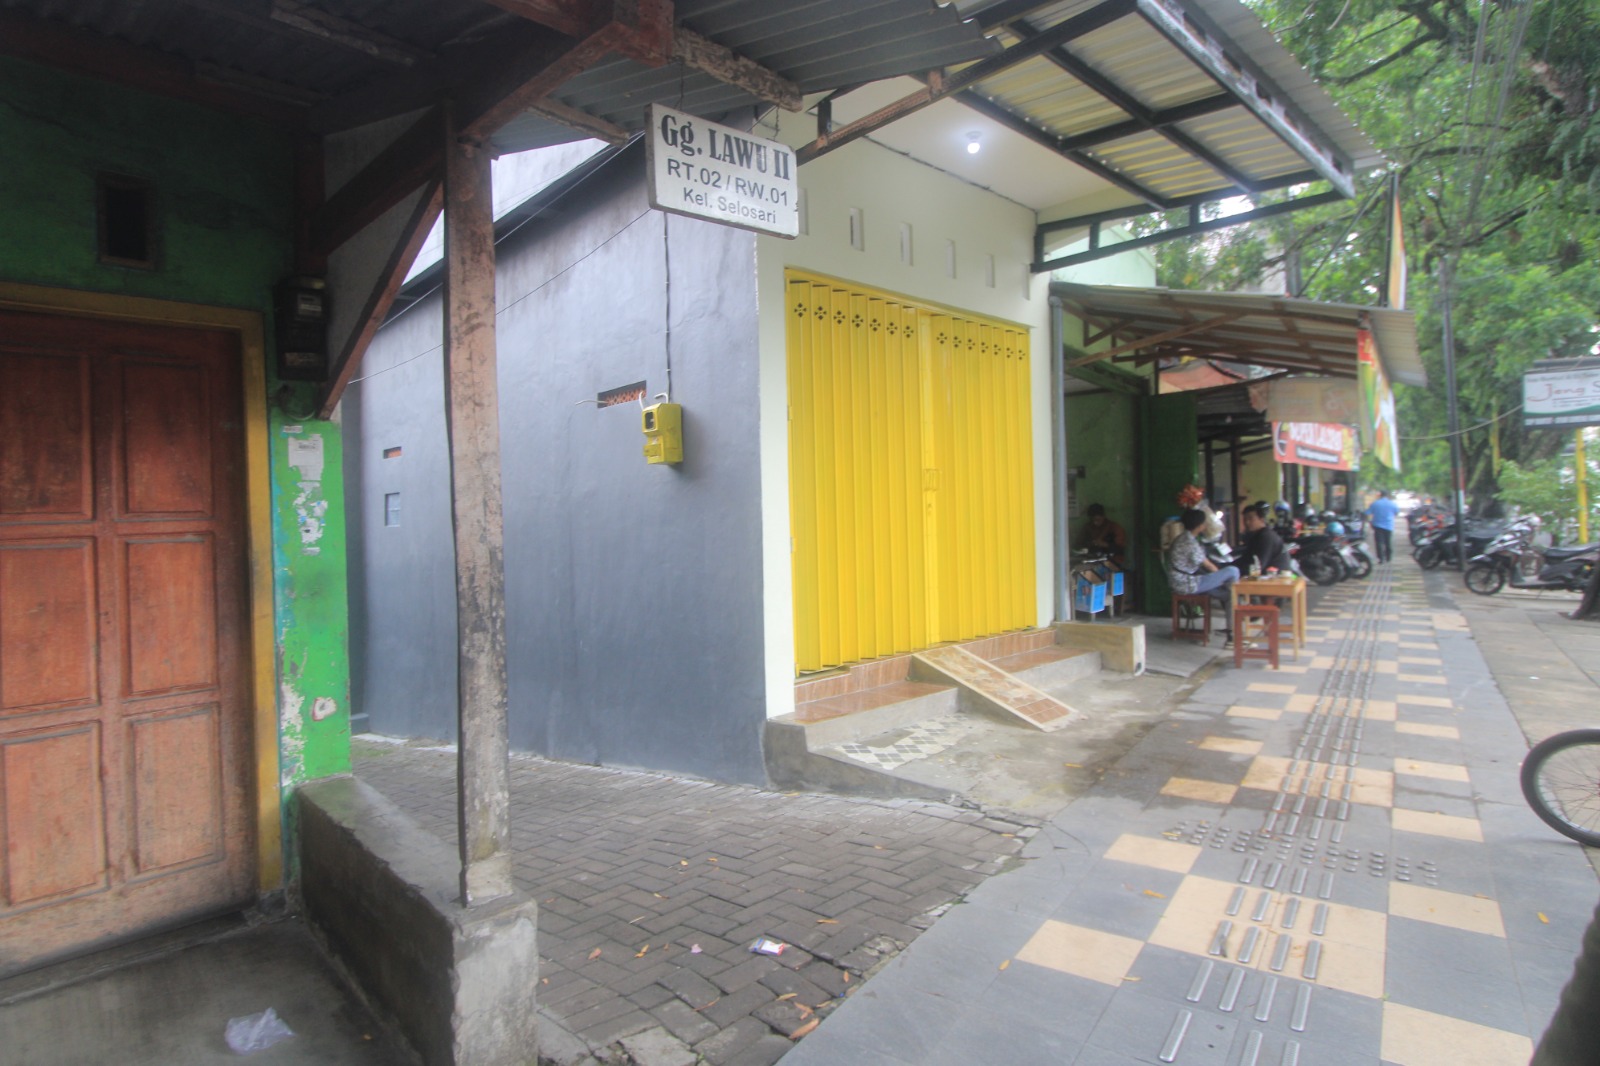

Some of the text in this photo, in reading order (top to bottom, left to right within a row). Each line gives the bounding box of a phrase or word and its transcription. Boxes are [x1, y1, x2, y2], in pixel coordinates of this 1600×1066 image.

[661, 114, 790, 180] Gg. LAWU II
[683, 187, 776, 223] Kel. Selosari
